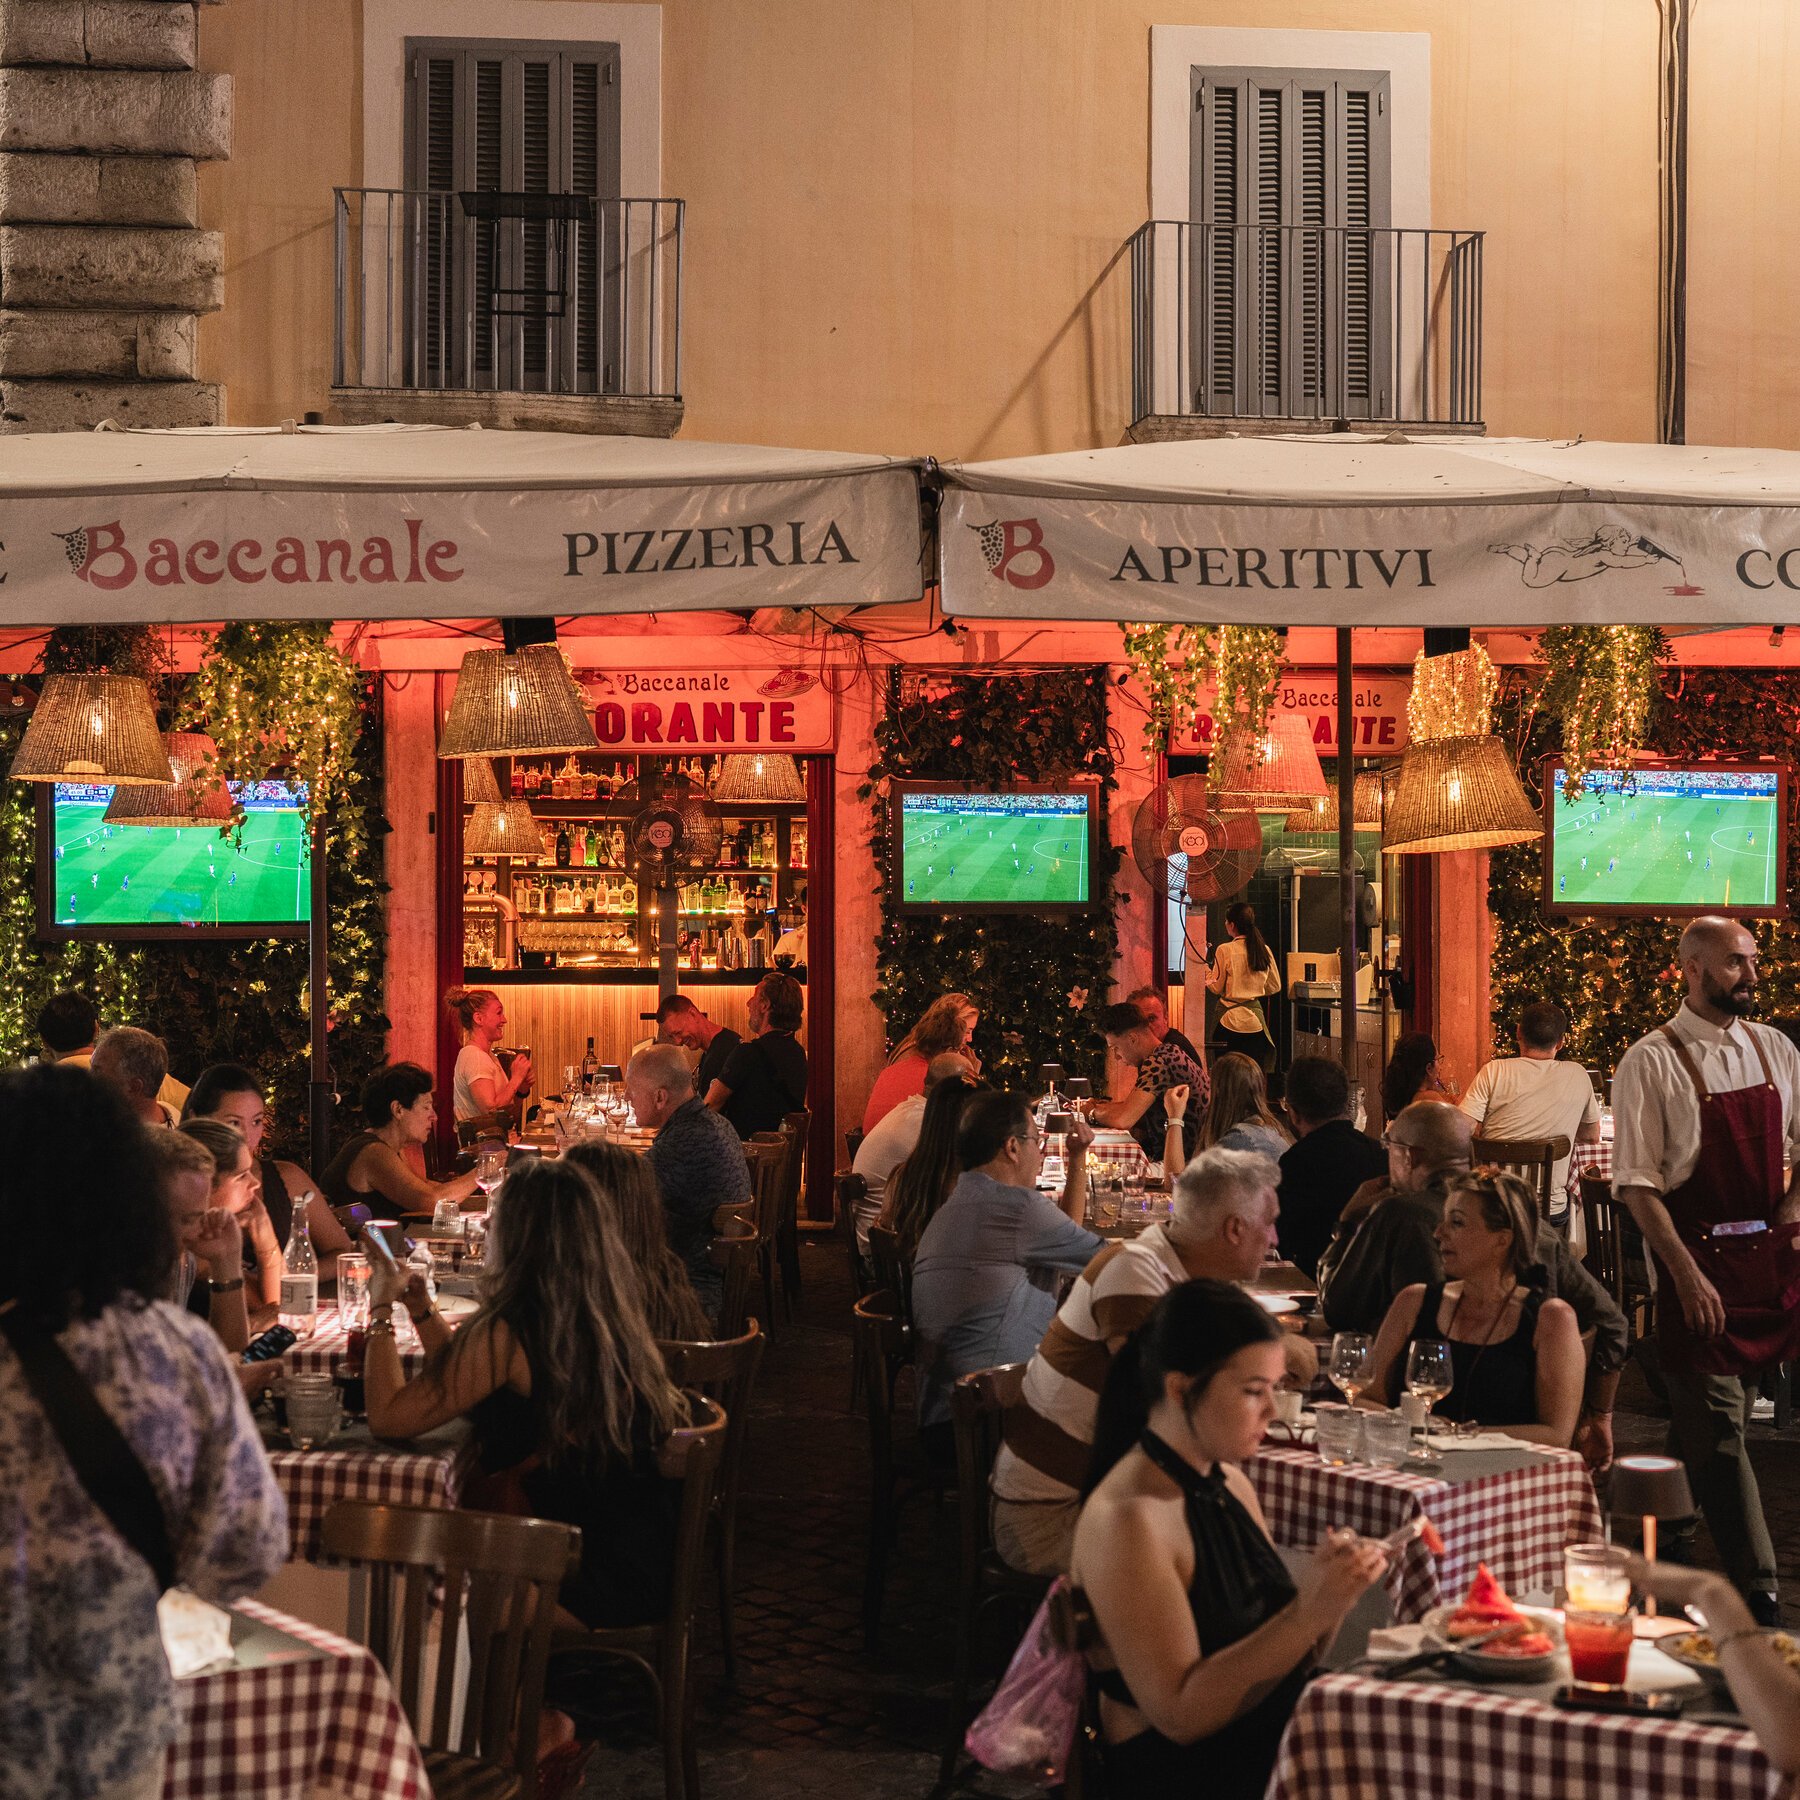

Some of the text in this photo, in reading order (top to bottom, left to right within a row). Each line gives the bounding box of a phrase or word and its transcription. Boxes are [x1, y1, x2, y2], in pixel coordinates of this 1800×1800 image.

[75, 519, 464, 590] Baccanale
[562, 520, 860, 577] PIZZERIA
[1109, 544, 1436, 589] APERITIVI
[622, 673, 730, 694] Baccanale
[1281, 688, 1383, 709] Baccaale
[595, 701, 796, 743] ORANTE
